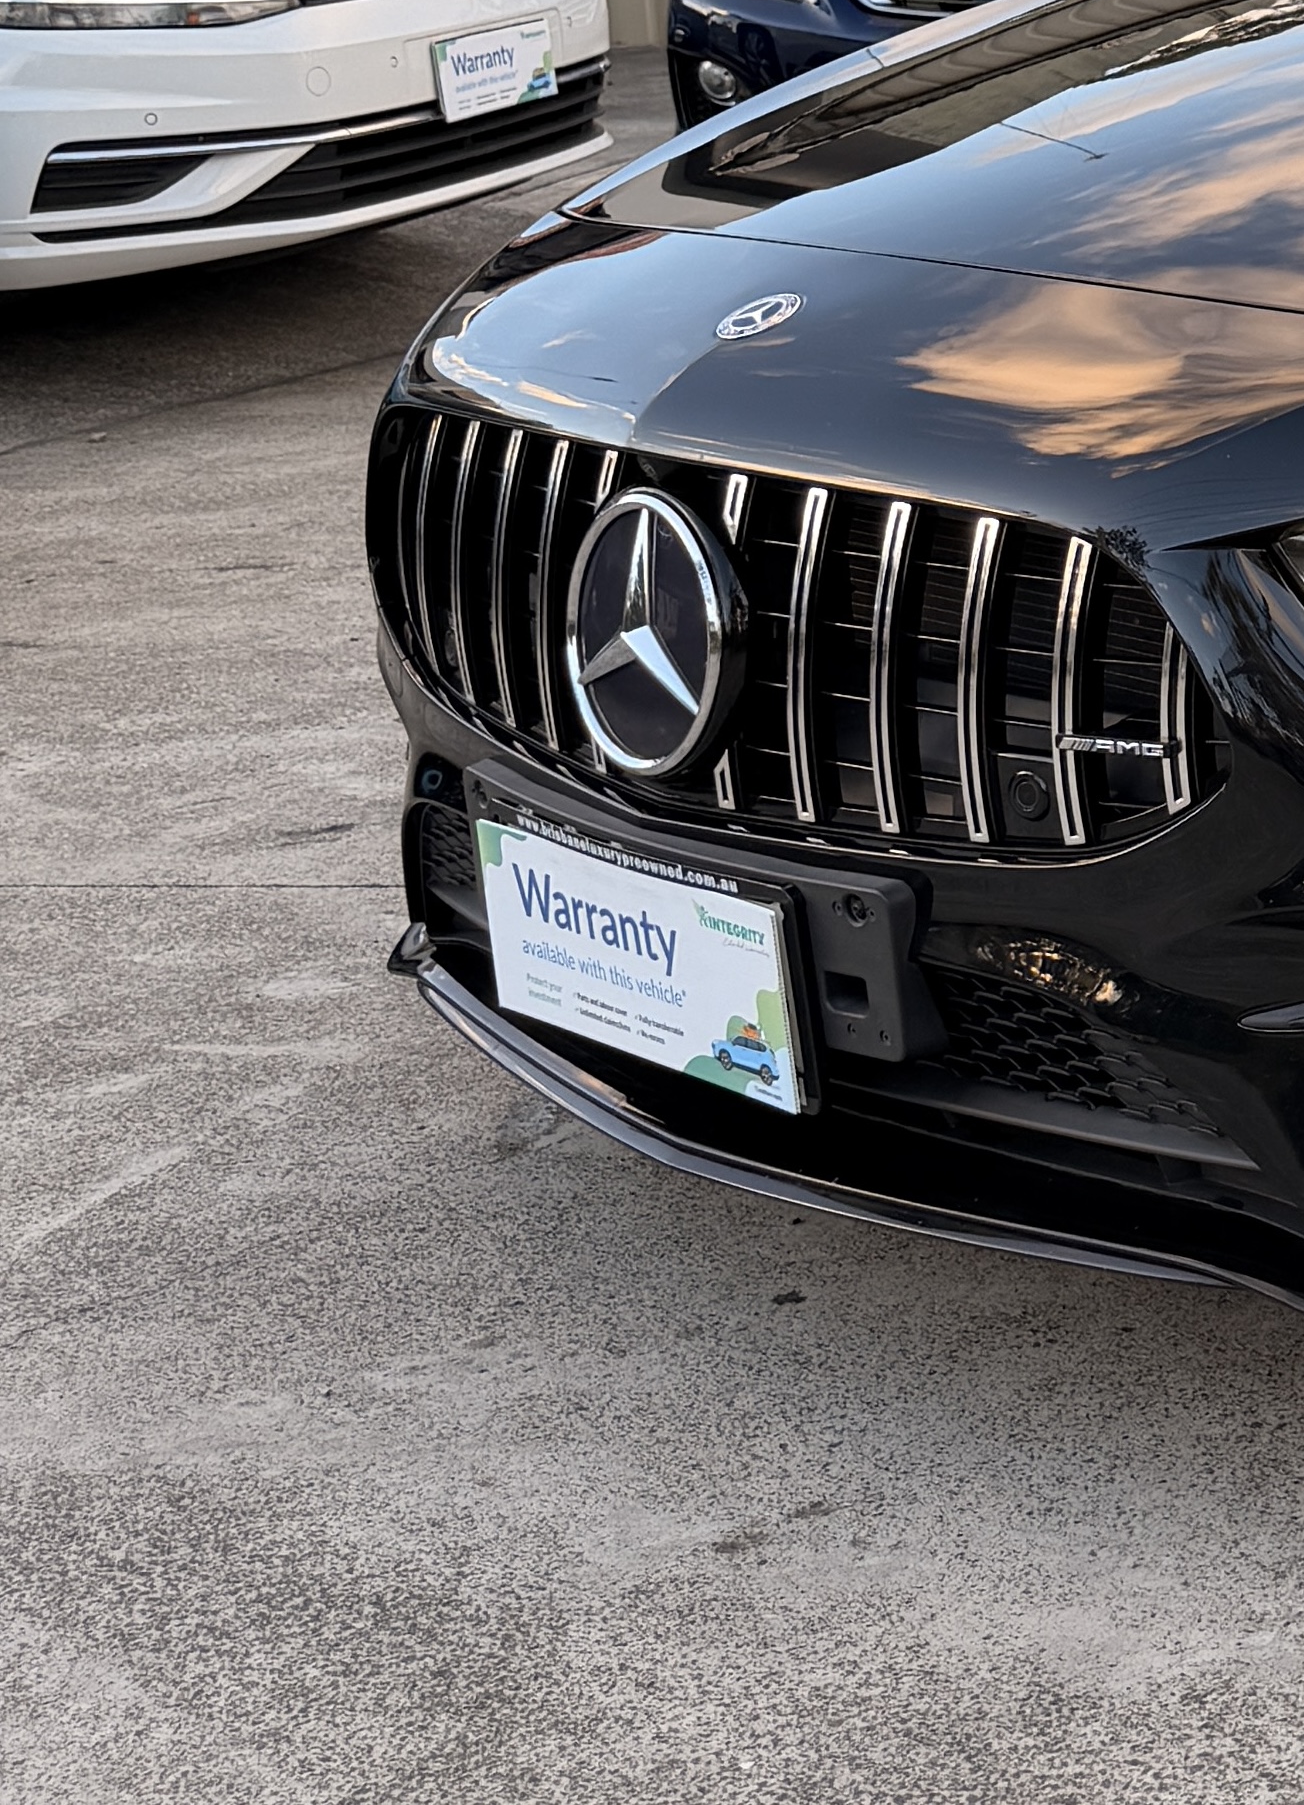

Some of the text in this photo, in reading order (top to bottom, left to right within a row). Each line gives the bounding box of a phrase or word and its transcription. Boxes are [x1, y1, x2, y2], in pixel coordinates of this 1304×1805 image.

[450, 45, 515, 76] Warranty
[1091, 738, 1164, 757] AMG
[511, 861, 677, 977] Warranty
[707, 915, 765, 946] INTEGRITY
[522, 939, 576, 971] available
[578, 956, 607, 982] with
[609, 965, 634, 991] this
